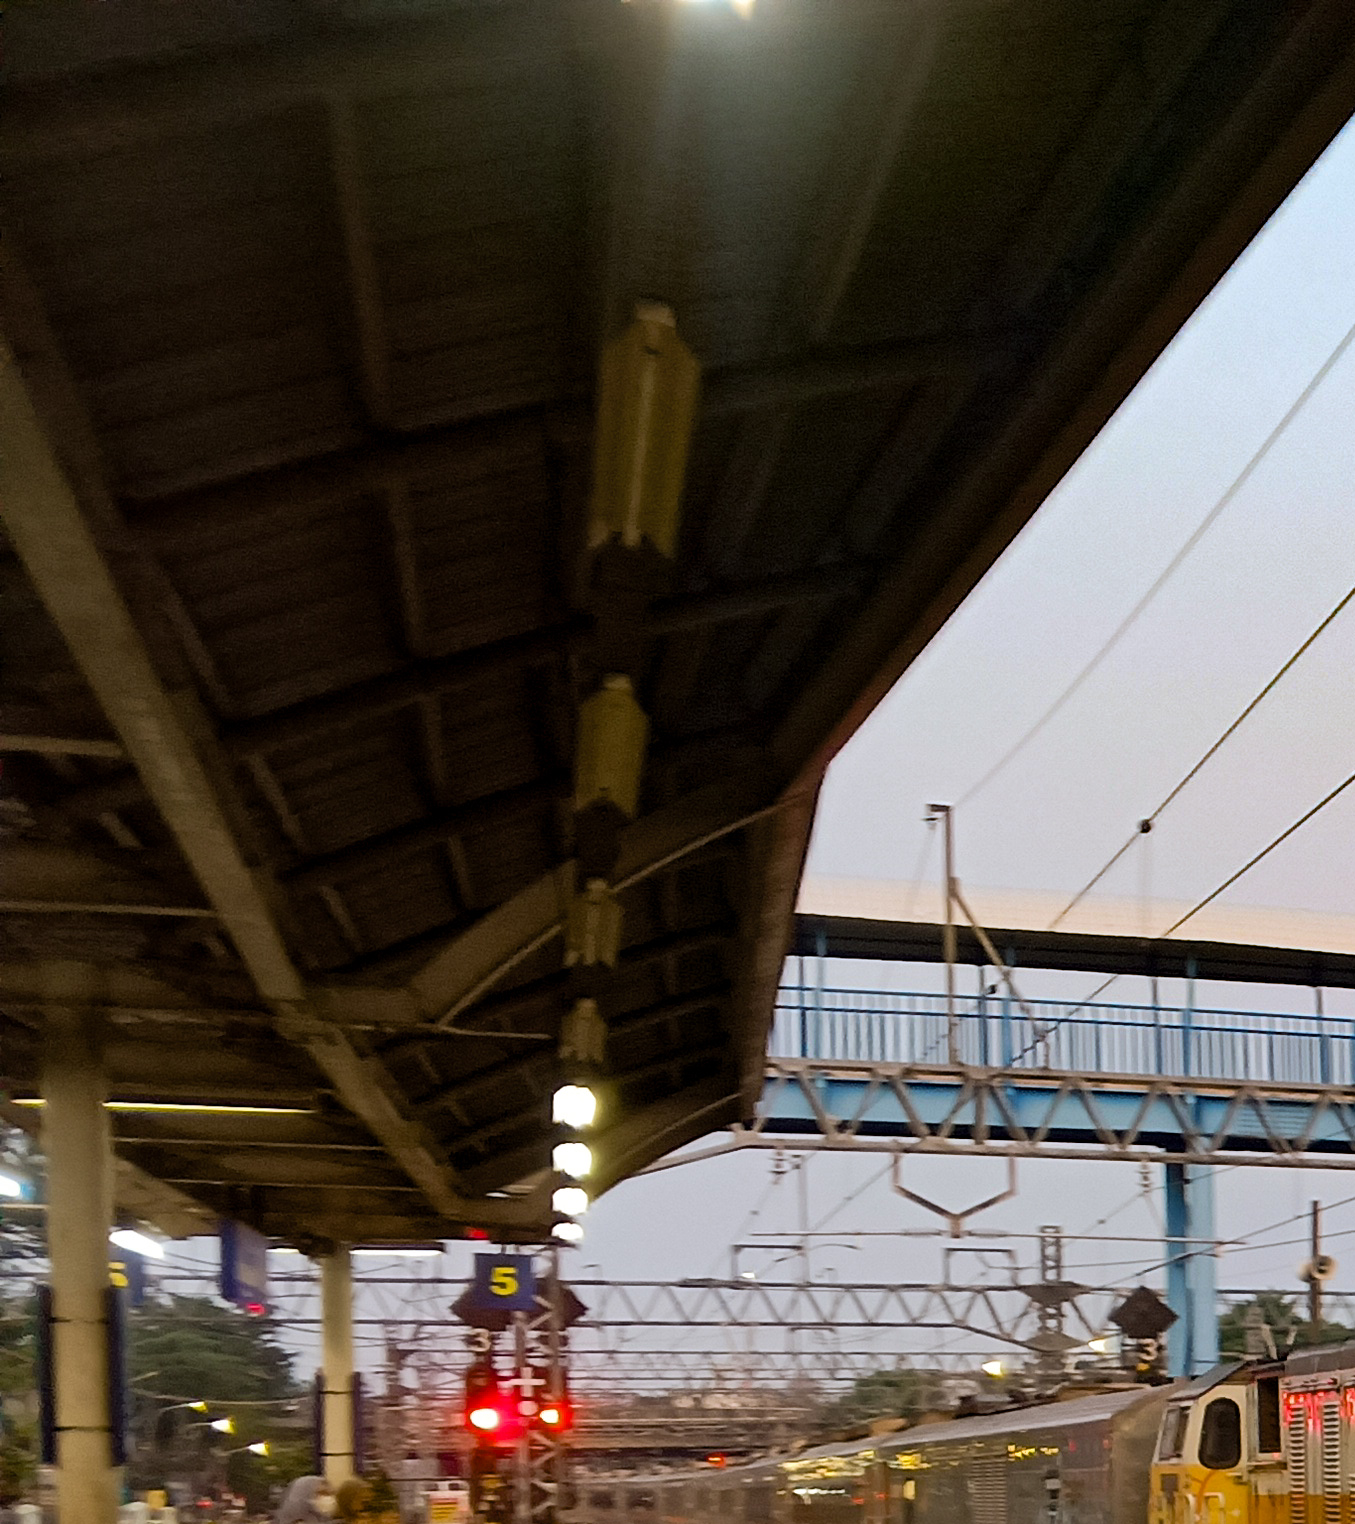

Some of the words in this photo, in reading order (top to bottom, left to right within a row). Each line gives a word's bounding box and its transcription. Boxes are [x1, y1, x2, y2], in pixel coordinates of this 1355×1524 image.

[489, 1266, 519, 1297] 5
[468, 1328, 492, 1353] 3
[1139, 1337, 1158, 1361] 3
